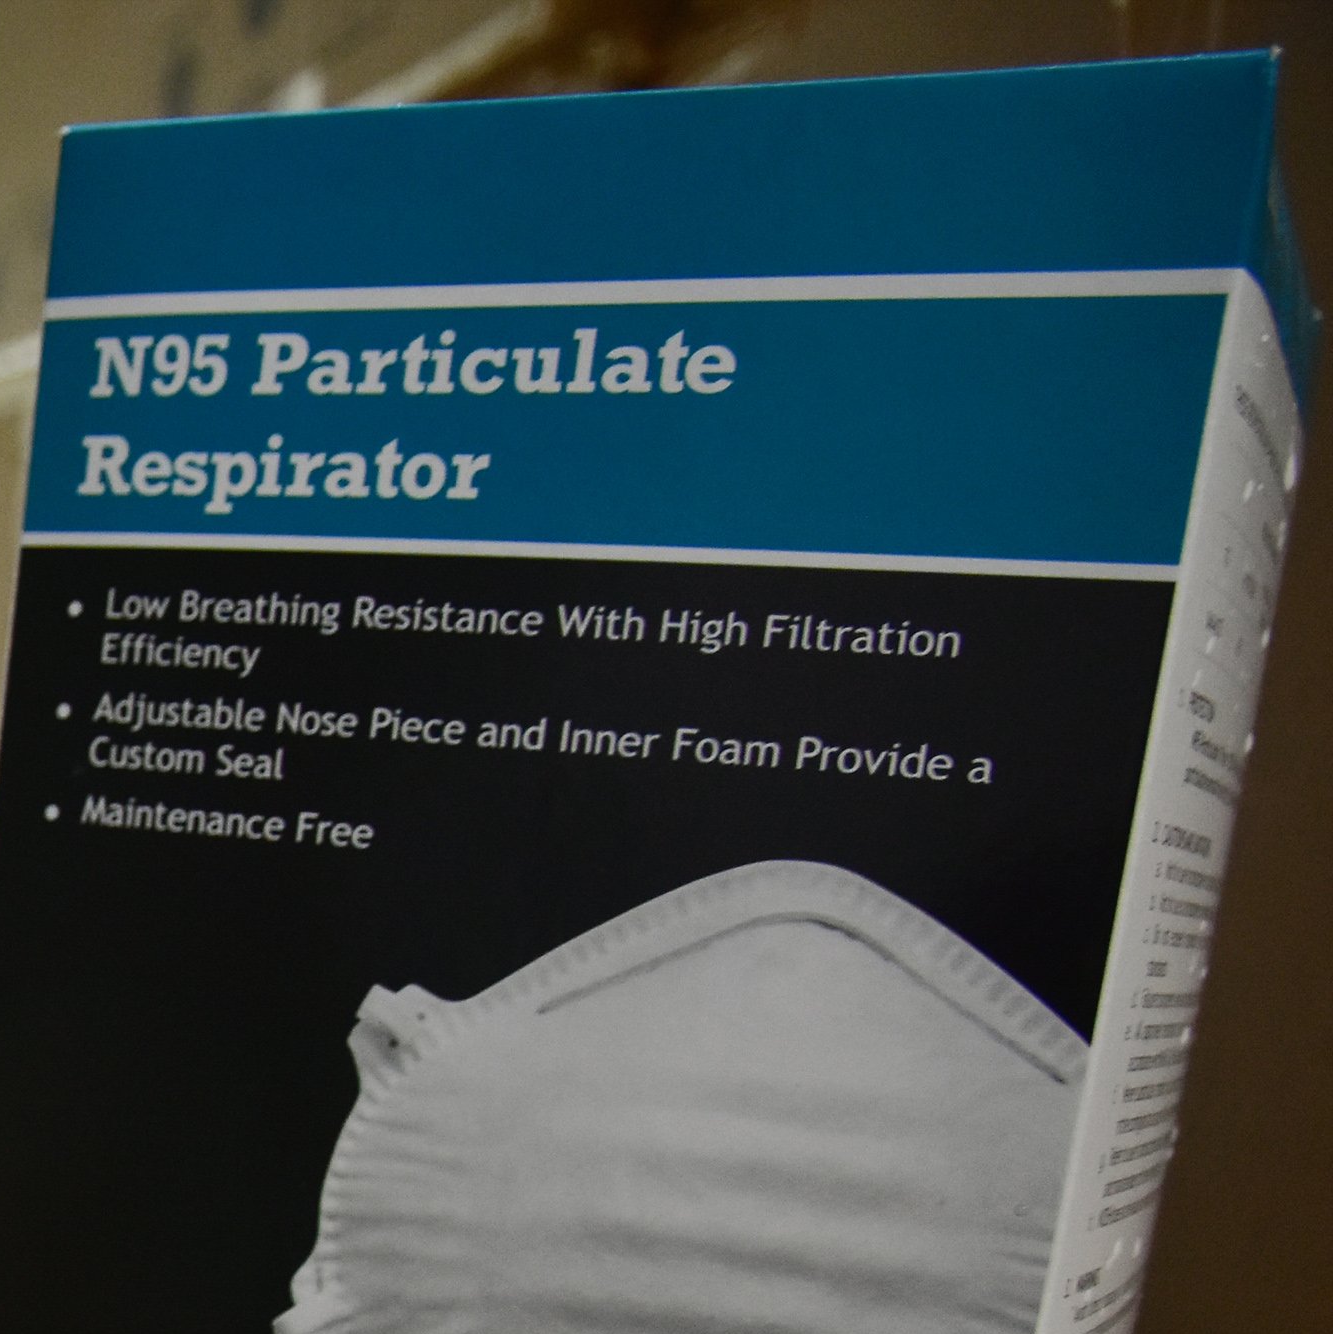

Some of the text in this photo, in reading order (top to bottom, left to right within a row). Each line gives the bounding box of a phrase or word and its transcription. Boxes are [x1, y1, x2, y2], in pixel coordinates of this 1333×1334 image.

[90, 328, 736, 397] N95 Particulate
[78, 434, 491, 514] Respirator
[101, 632, 261, 678] Efficiency
[106, 588, 961, 658] Low Breathing Resistance With High Filtration
[88, 735, 284, 780] Custom Seal
[93, 692, 992, 785] Adjustable Nose Piece and Inner Foam Provide a
[81, 795, 374, 850] Maintenance Free
